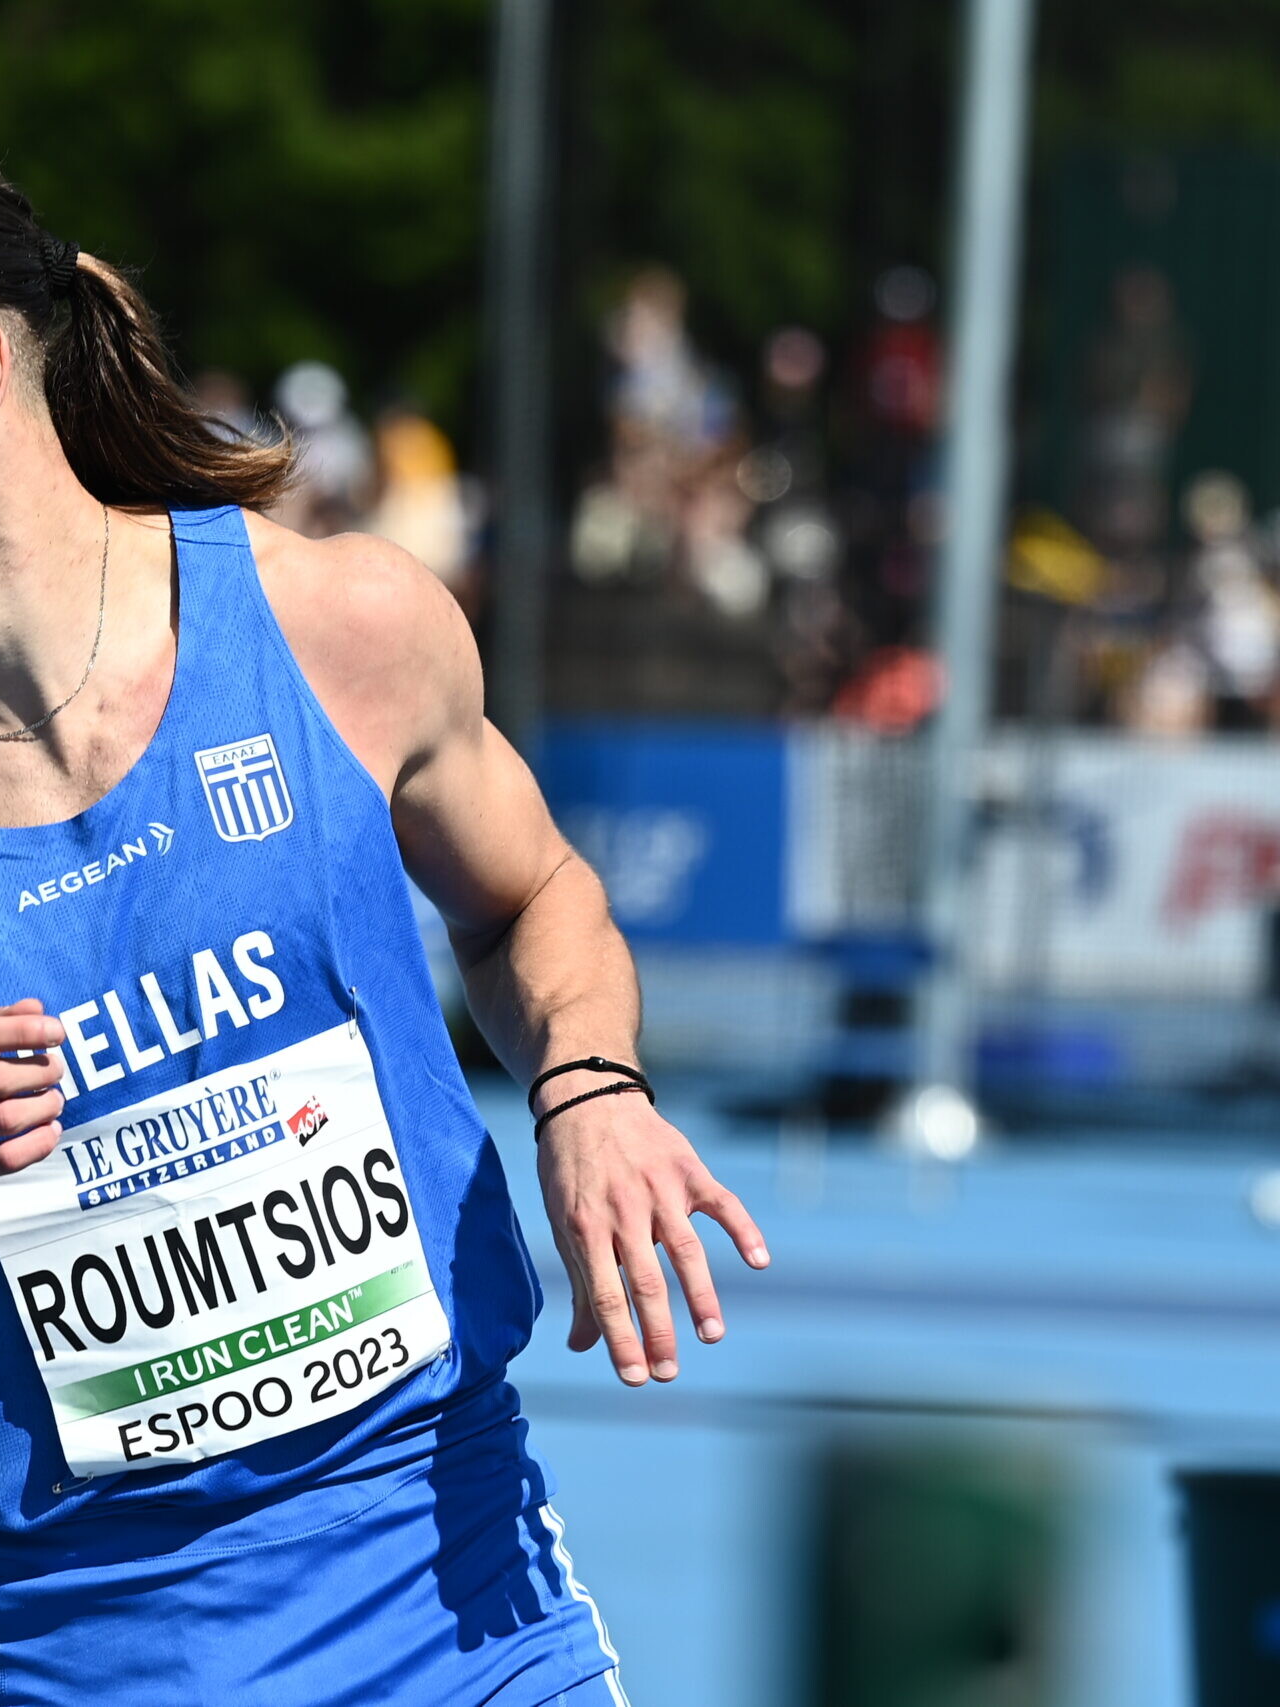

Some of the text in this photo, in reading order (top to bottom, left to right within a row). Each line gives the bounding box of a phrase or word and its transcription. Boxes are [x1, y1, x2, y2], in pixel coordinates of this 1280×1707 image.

[18, 836, 148, 912] AEGEAN
[62, 1136, 113, 1186] LE
[87, 1128, 276, 1206] SWITZERLAND
[17, 1148, 409, 1361] ROUMTSIOS
[118, 1328, 409, 1462] ESPOO 2023
[133, 1368, 147, 1396] I
[150, 1340, 233, 1391] RUN
